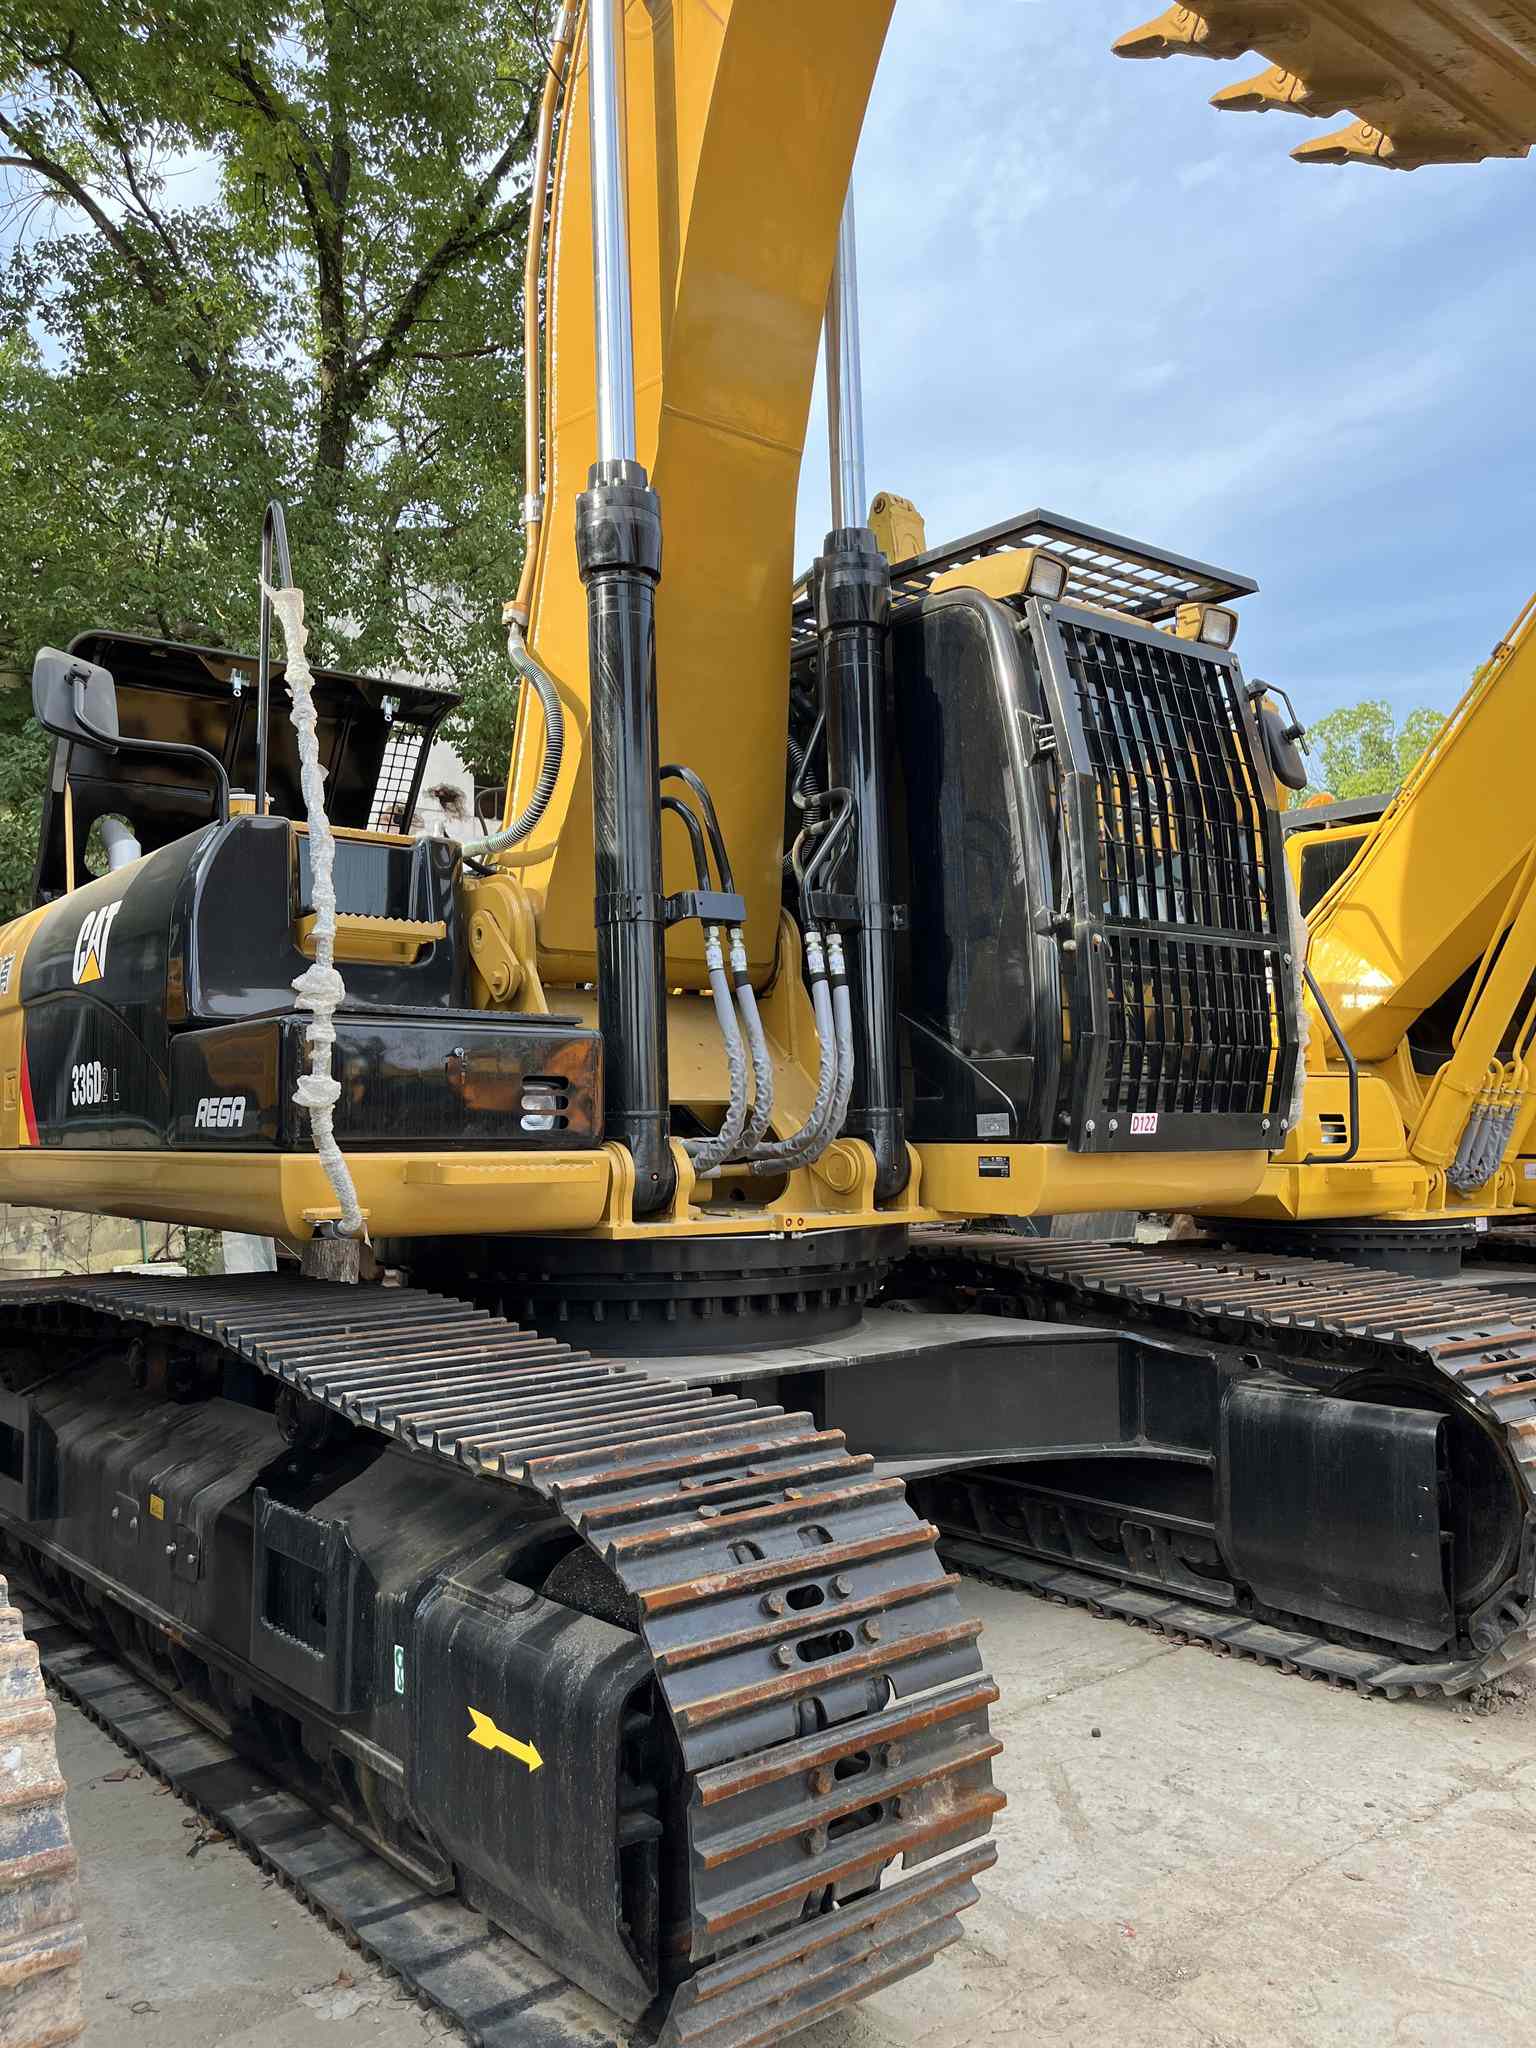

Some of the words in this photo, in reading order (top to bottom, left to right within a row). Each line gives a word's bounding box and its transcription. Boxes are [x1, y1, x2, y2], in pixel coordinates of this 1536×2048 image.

[72, 900, 123, 984] CAT
[194, 1096, 246, 1128] REGA
[1132, 1116, 1156, 1132] D122
